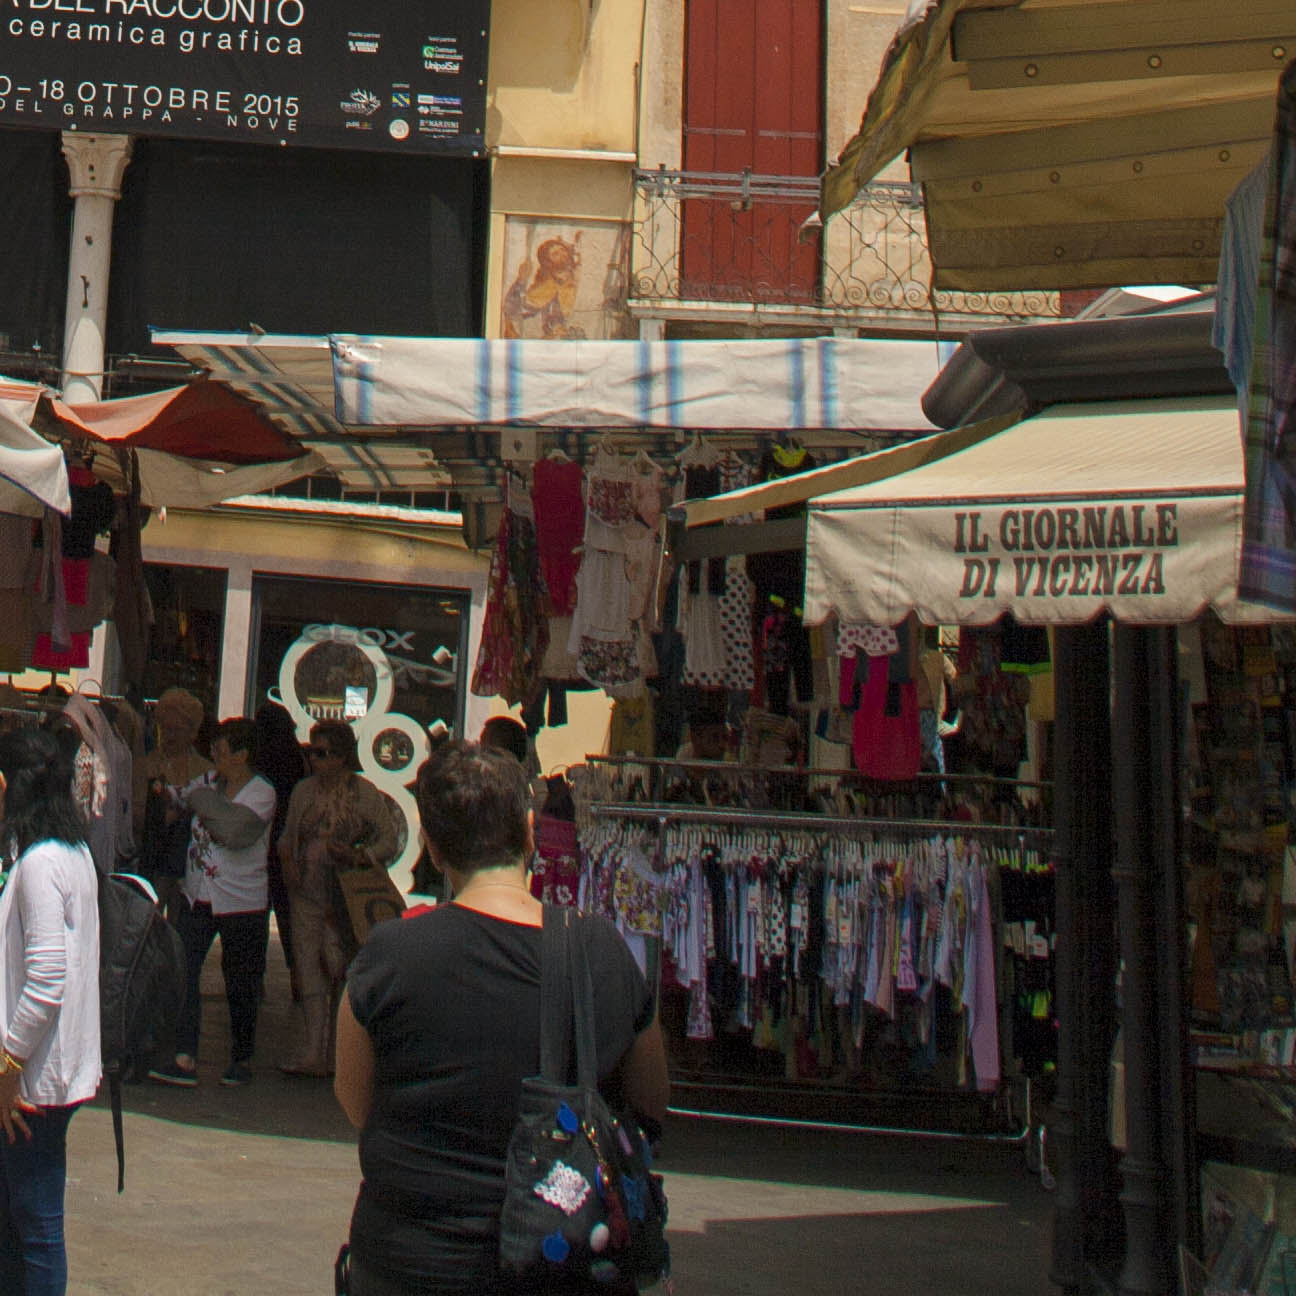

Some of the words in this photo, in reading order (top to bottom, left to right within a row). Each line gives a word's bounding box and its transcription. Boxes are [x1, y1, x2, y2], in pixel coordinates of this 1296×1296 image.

[8, 17, 166, 46] ceramica
[179, 29, 303, 55] grafica
[77, 80, 232, 112] OTTOBRE
[243, 92, 300, 117] 2015
[62, 103, 173, 123] GRAPPA
[227, 114, 298, 132] NOVE
[954, 512, 990, 554] IL
[999, 504, 1179, 552] GIORNALE
[959, 557, 1001, 598] DI
[1012, 553, 1166, 598] VICENZA
[302, 623, 416, 651] GEOX
